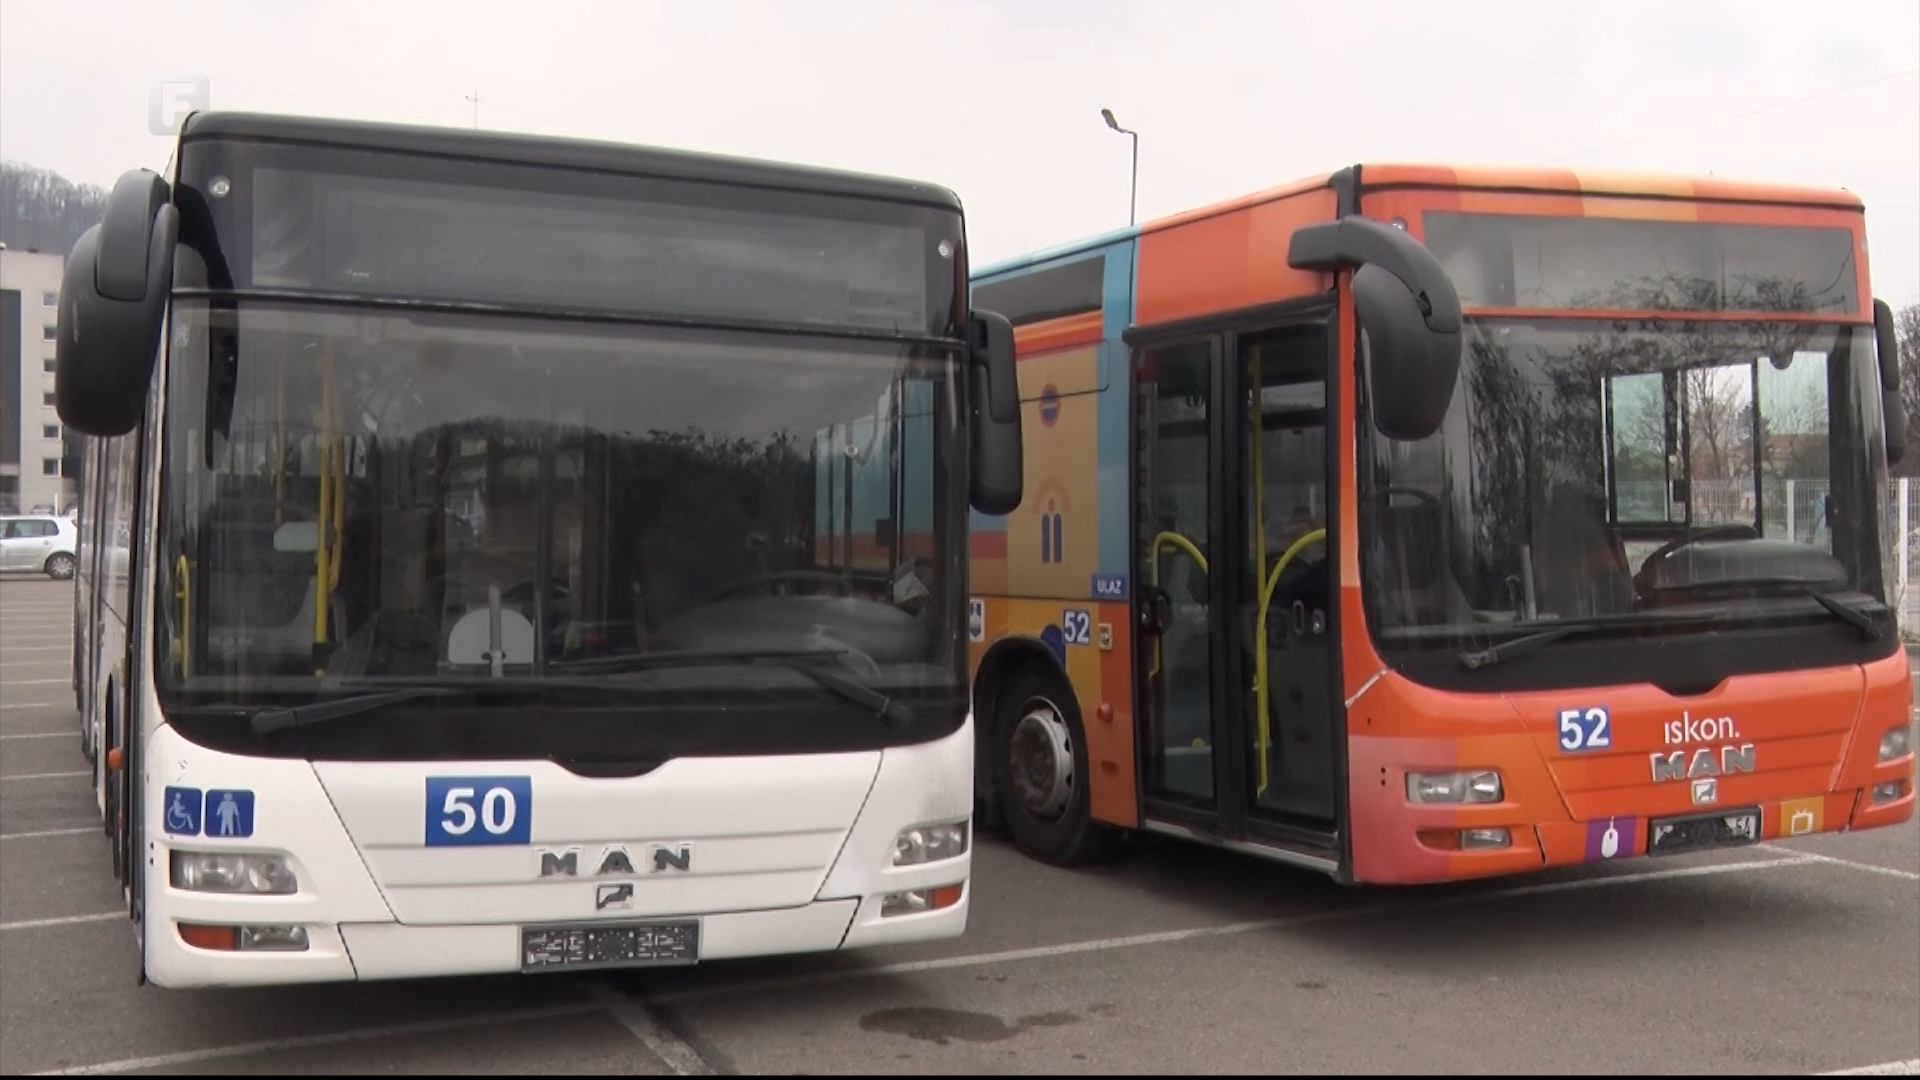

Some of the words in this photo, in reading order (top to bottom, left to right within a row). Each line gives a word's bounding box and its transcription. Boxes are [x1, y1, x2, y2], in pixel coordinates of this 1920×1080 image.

[1097, 579, 1122, 594] ULAZ
[1064, 611, 1089, 643] 52
[1560, 707, 1610, 750] 52
[1650, 744, 1755, 782] MAN
[441, 787, 516, 835] 50
[536, 842, 693, 877] MAN
